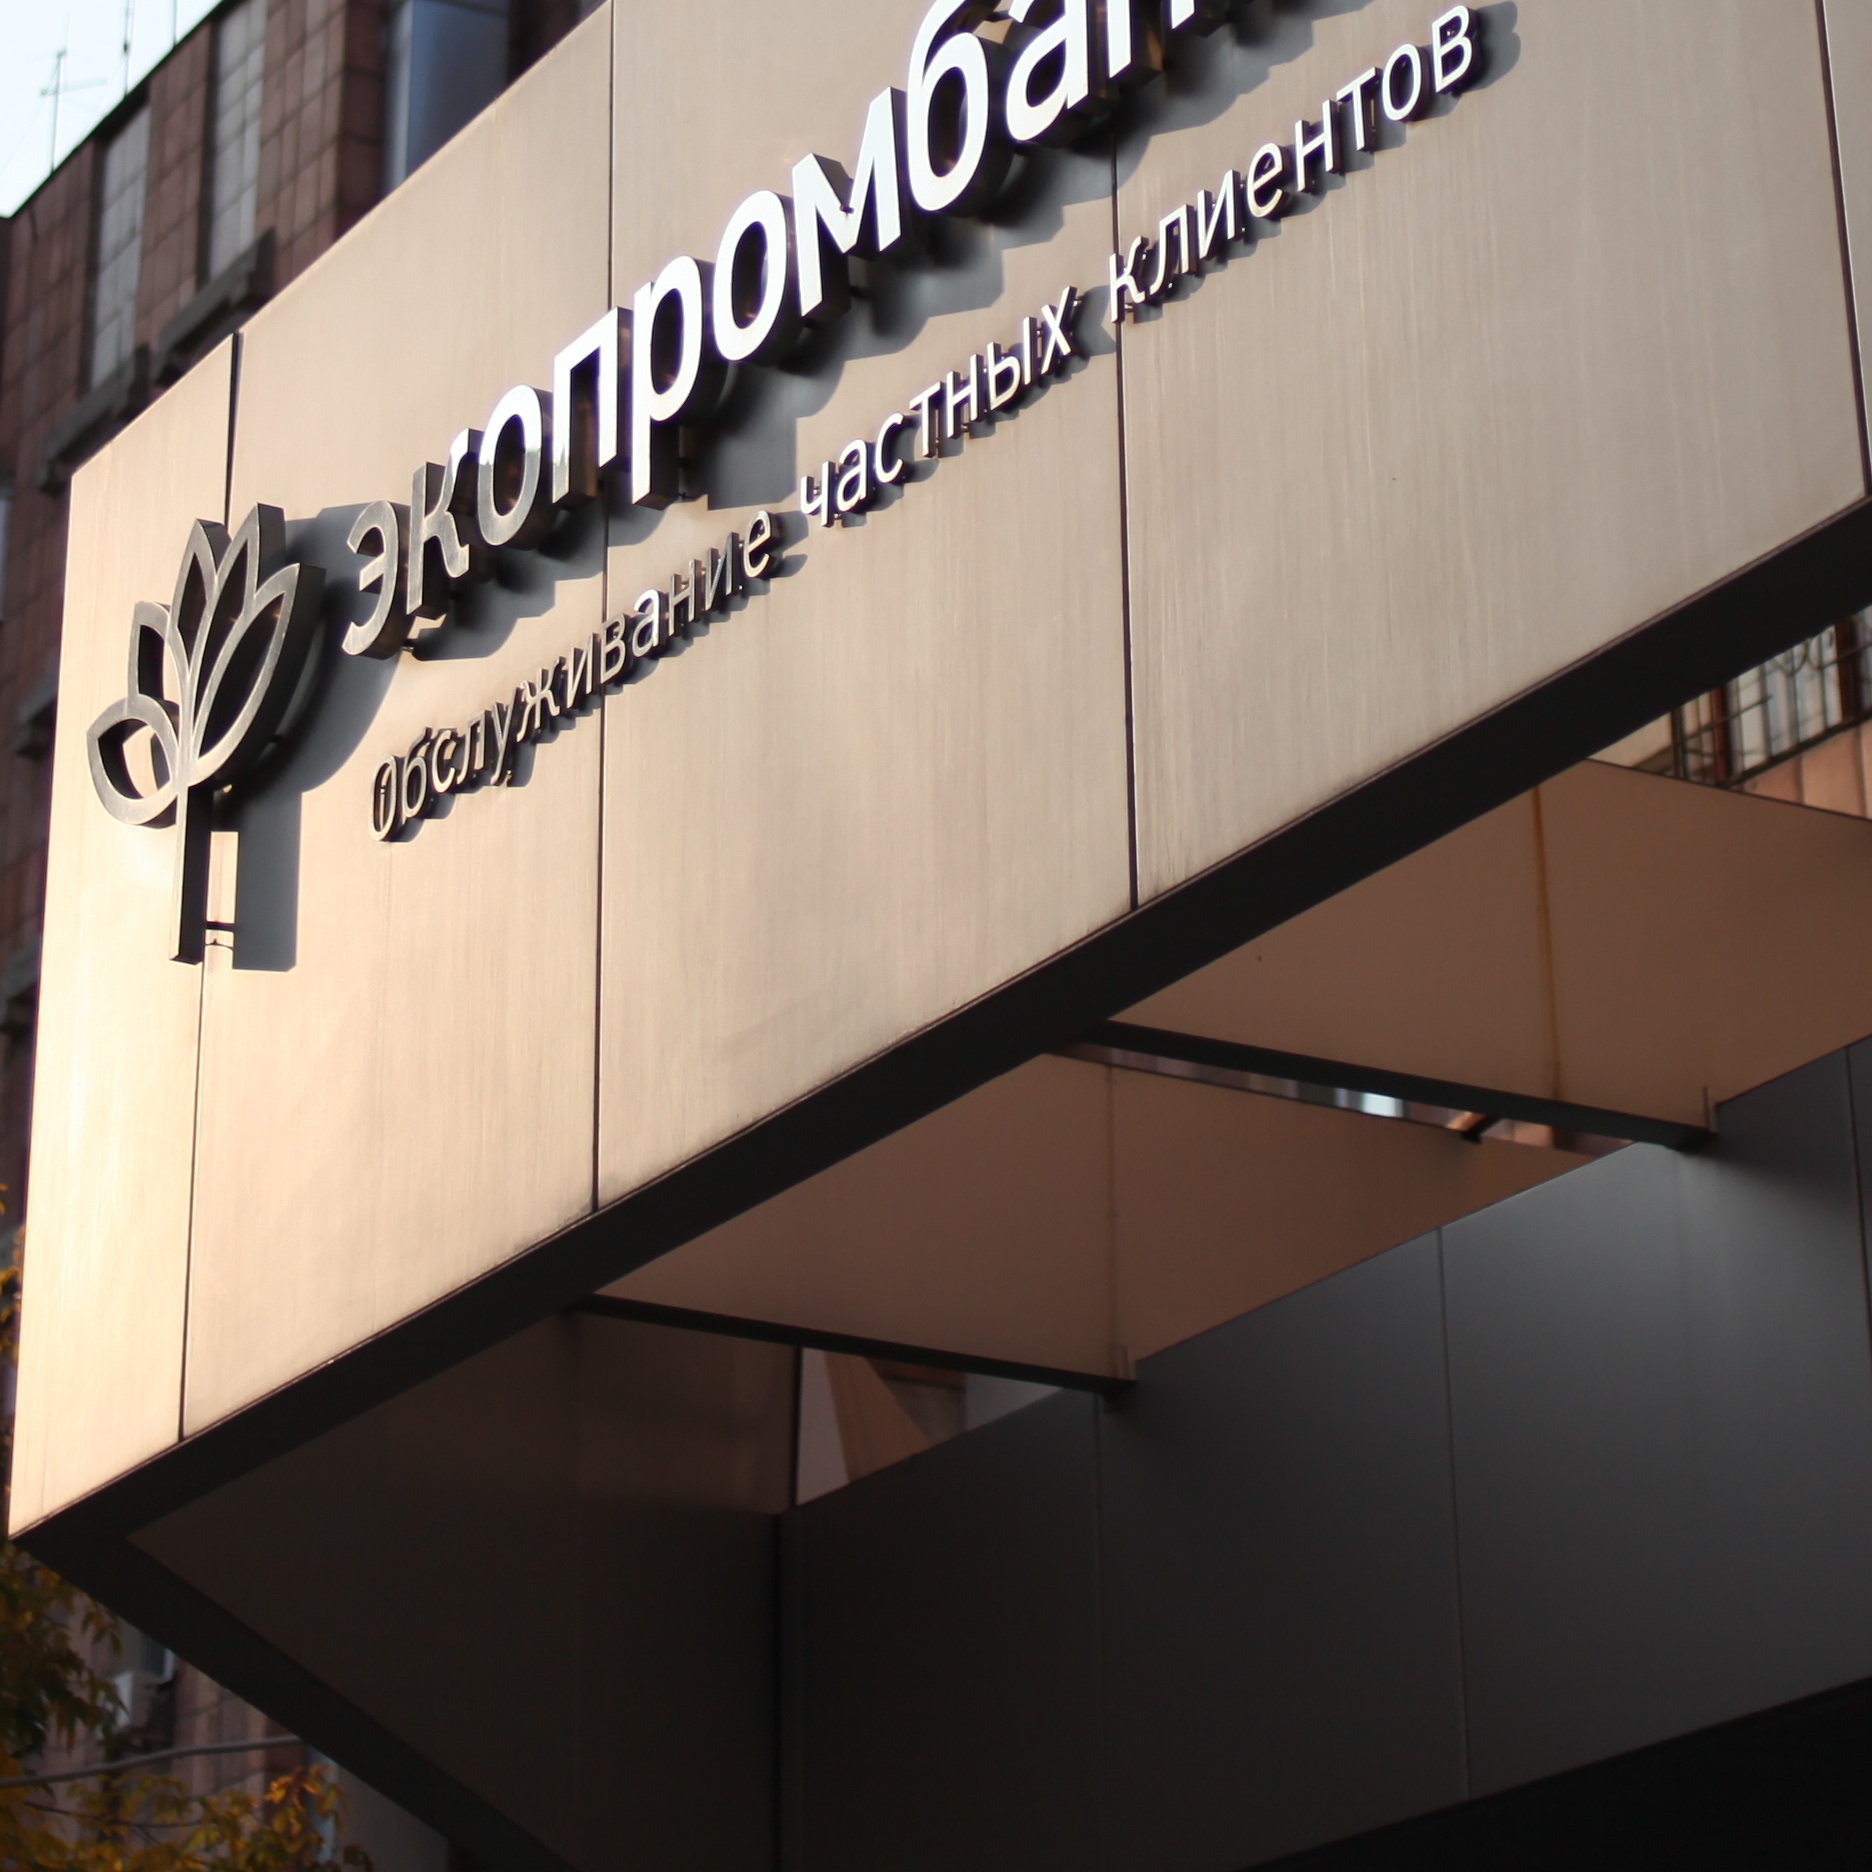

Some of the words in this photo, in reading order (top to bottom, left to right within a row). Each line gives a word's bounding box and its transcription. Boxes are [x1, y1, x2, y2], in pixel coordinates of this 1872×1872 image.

[369, 510, 774, 842] Обслуживание
[799, 285, 1079, 528] частных
[1108, 4, 1476, 324] клиентов
